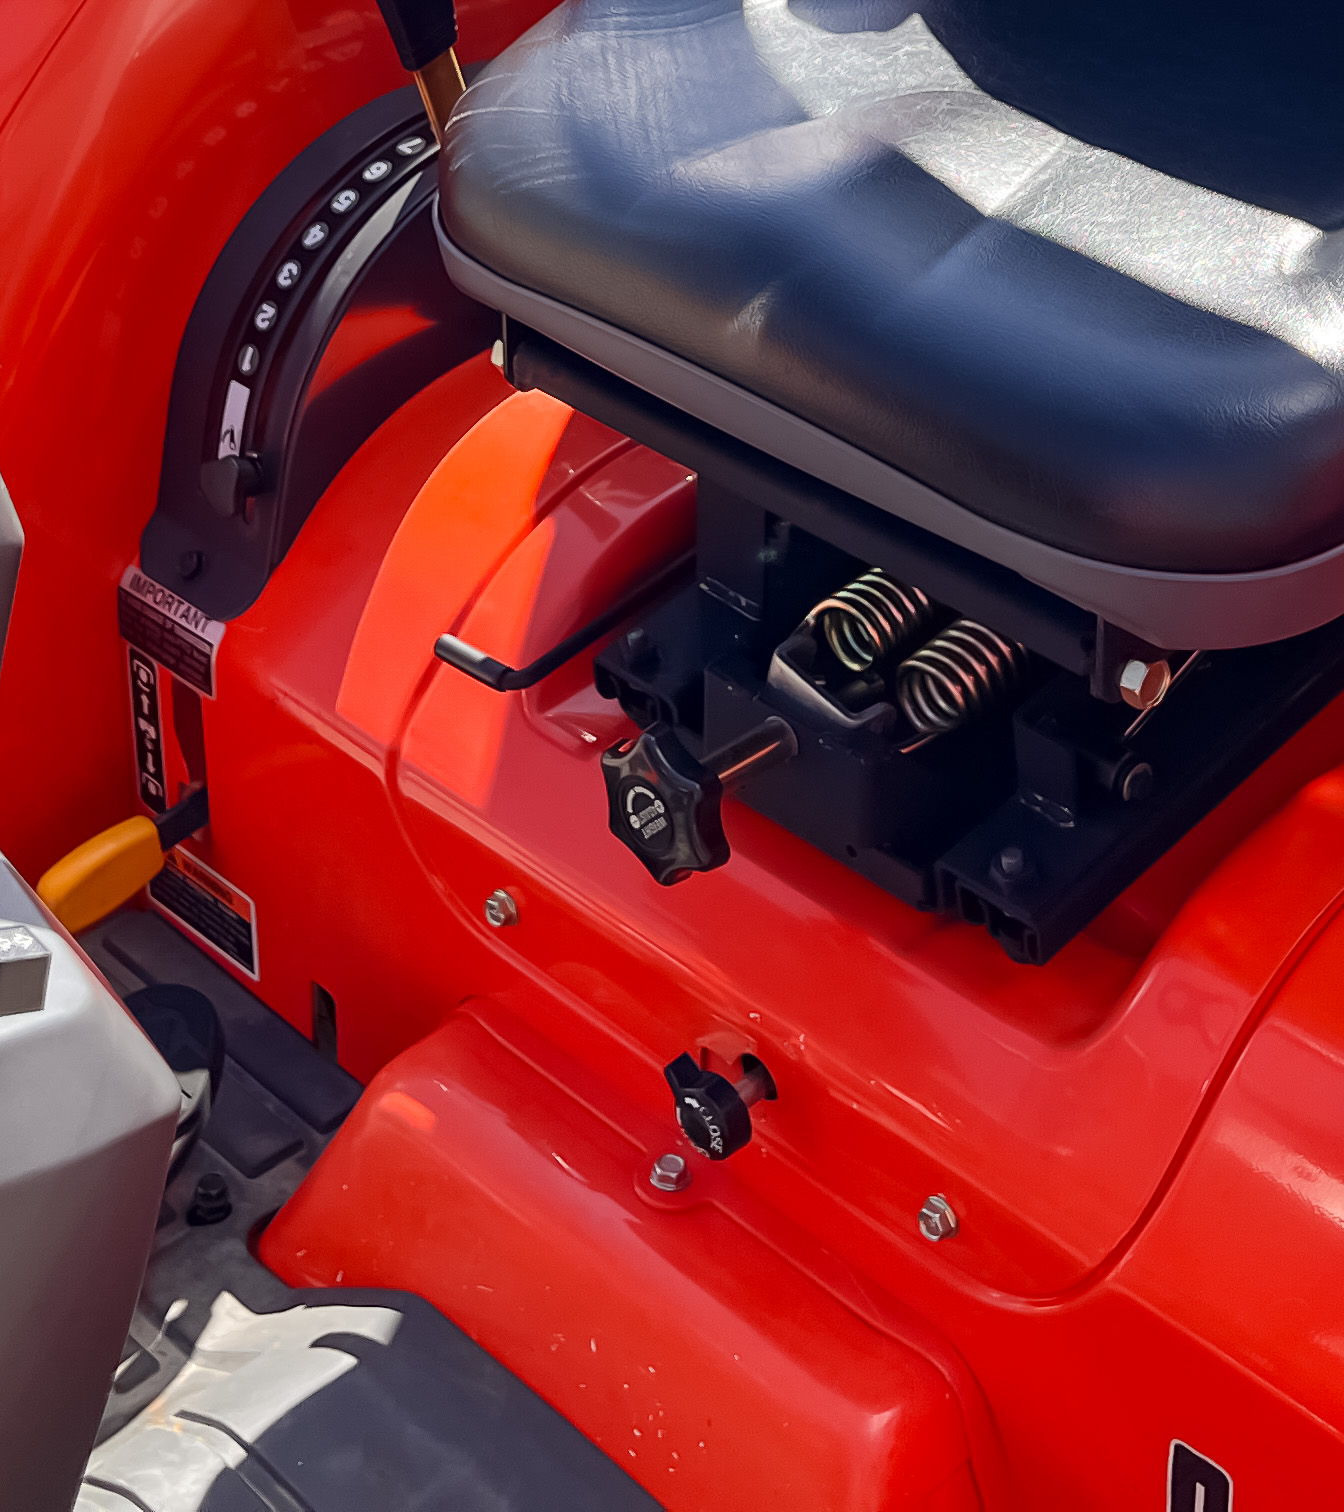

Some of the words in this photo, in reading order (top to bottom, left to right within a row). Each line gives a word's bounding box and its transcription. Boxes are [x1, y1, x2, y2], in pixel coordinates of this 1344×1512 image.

[397, 138, 423, 154] 7
[362, 161, 388, 180] 6
[333, 189, 356, 212] 5
[304, 224, 325, 247] 4
[278, 262, 298, 287] 3
[256, 303, 276, 330] 2
[242, 346, 253, 371] 1
[129, 573, 210, 633] IMPORTANT
